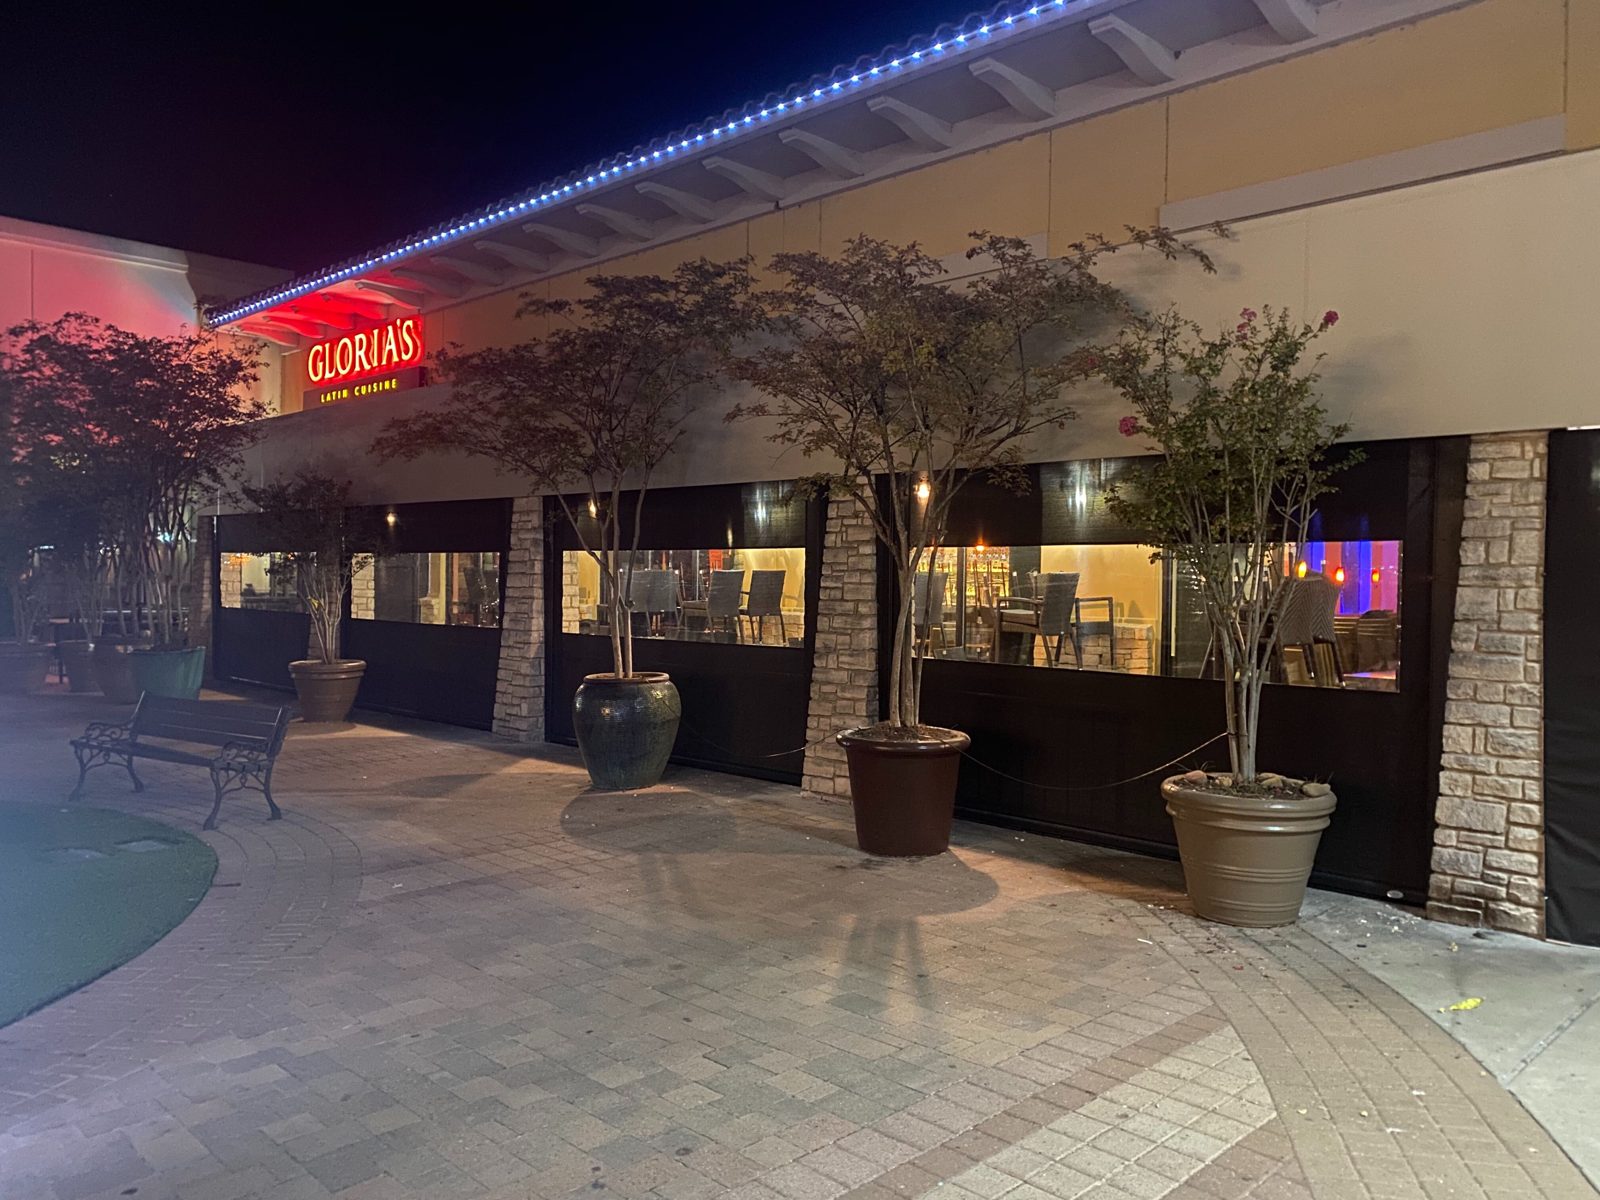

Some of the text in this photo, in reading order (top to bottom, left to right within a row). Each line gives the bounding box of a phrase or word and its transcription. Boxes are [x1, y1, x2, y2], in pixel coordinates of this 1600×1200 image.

[308, 318, 414, 382] GLORIA'S
[320, 379, 397, 403] LATIN CUISINE
